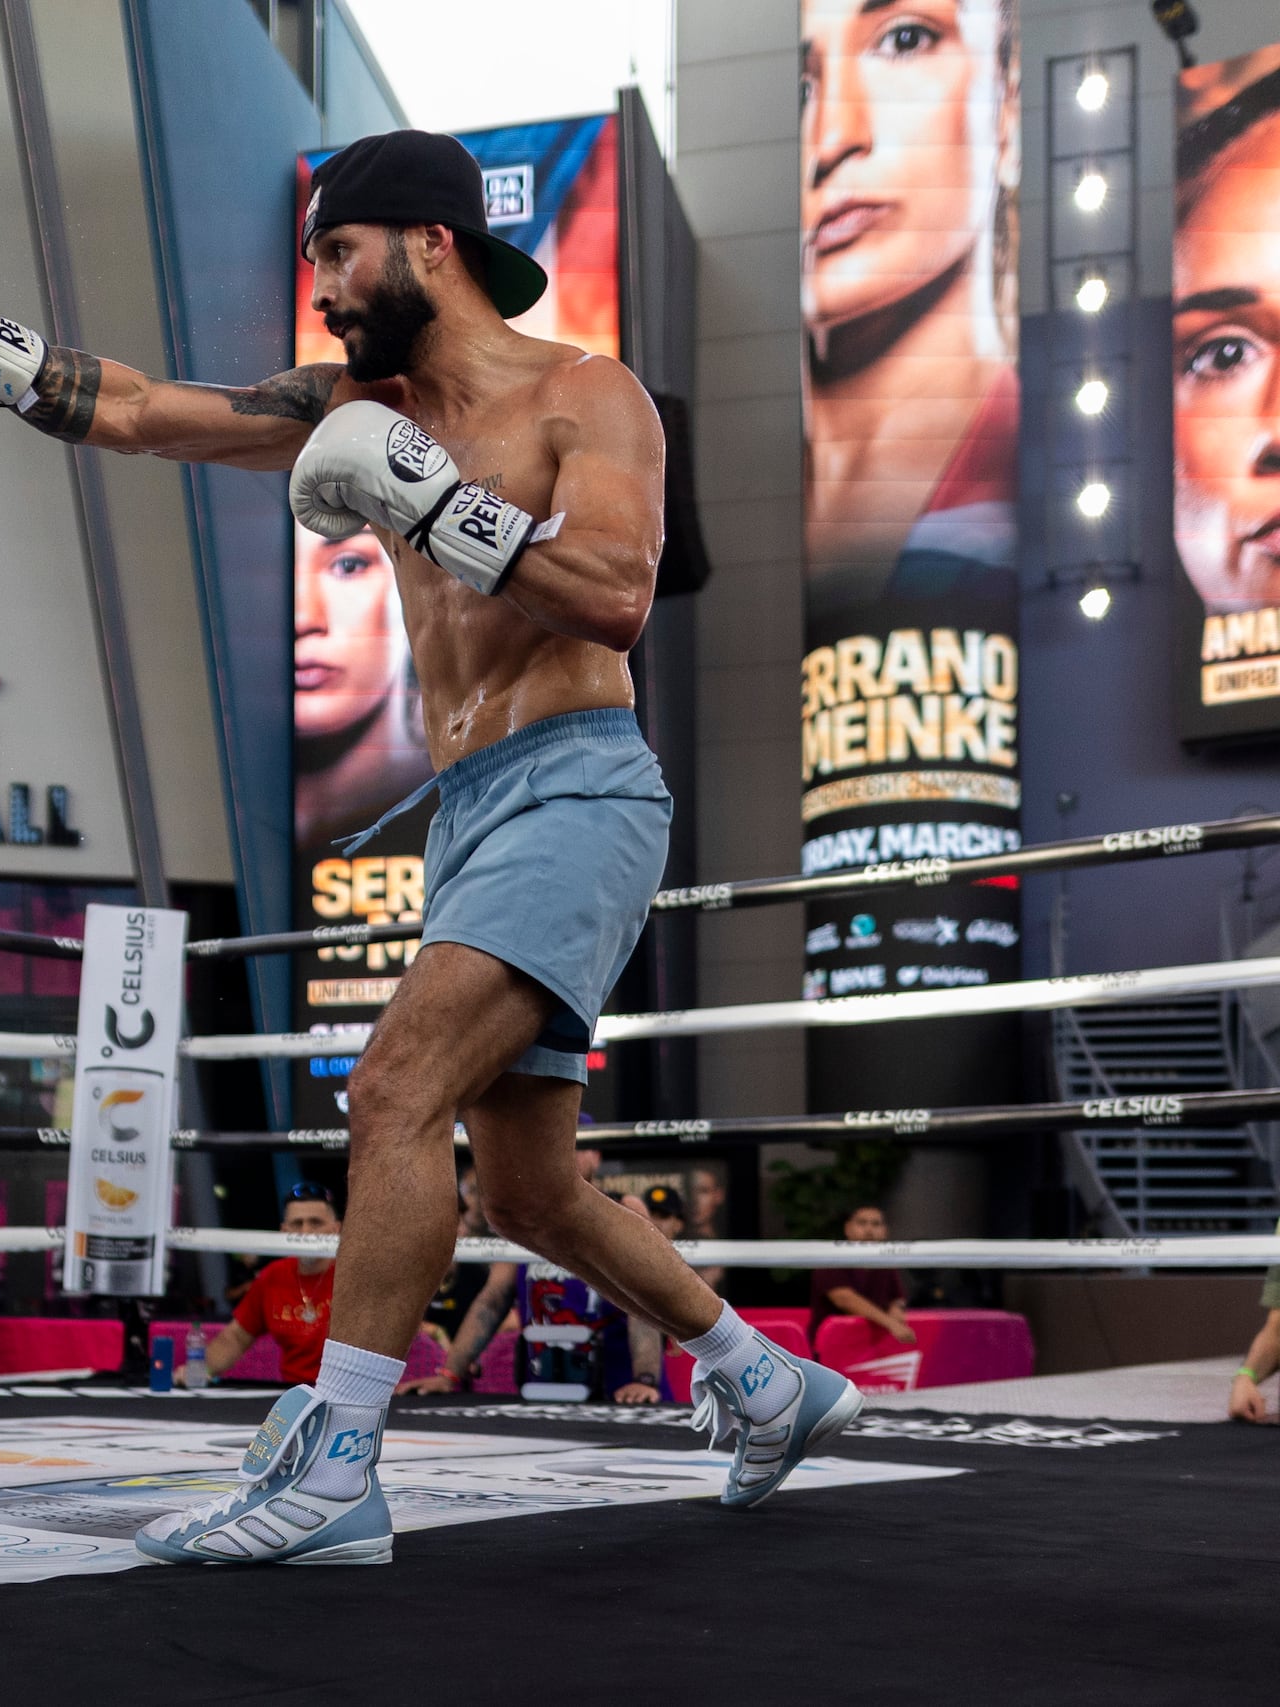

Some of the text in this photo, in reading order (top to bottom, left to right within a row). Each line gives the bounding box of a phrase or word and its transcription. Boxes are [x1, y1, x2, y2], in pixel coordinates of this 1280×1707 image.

[1201, 606, 1280, 662] AMA
[802, 693, 1017, 782] MEINKE
[879, 821, 1003, 861] MARCH
[1103, 823, 1205, 852] CELSIUS
[654, 883, 732, 909] CELSIUS
[120, 910, 145, 1006] CELSIUS
[844, 1109, 931, 1126] CELSIUS
[1083, 1095, 1184, 1118] CELSIUS
[91, 1149, 146, 1165] CELSIUS
